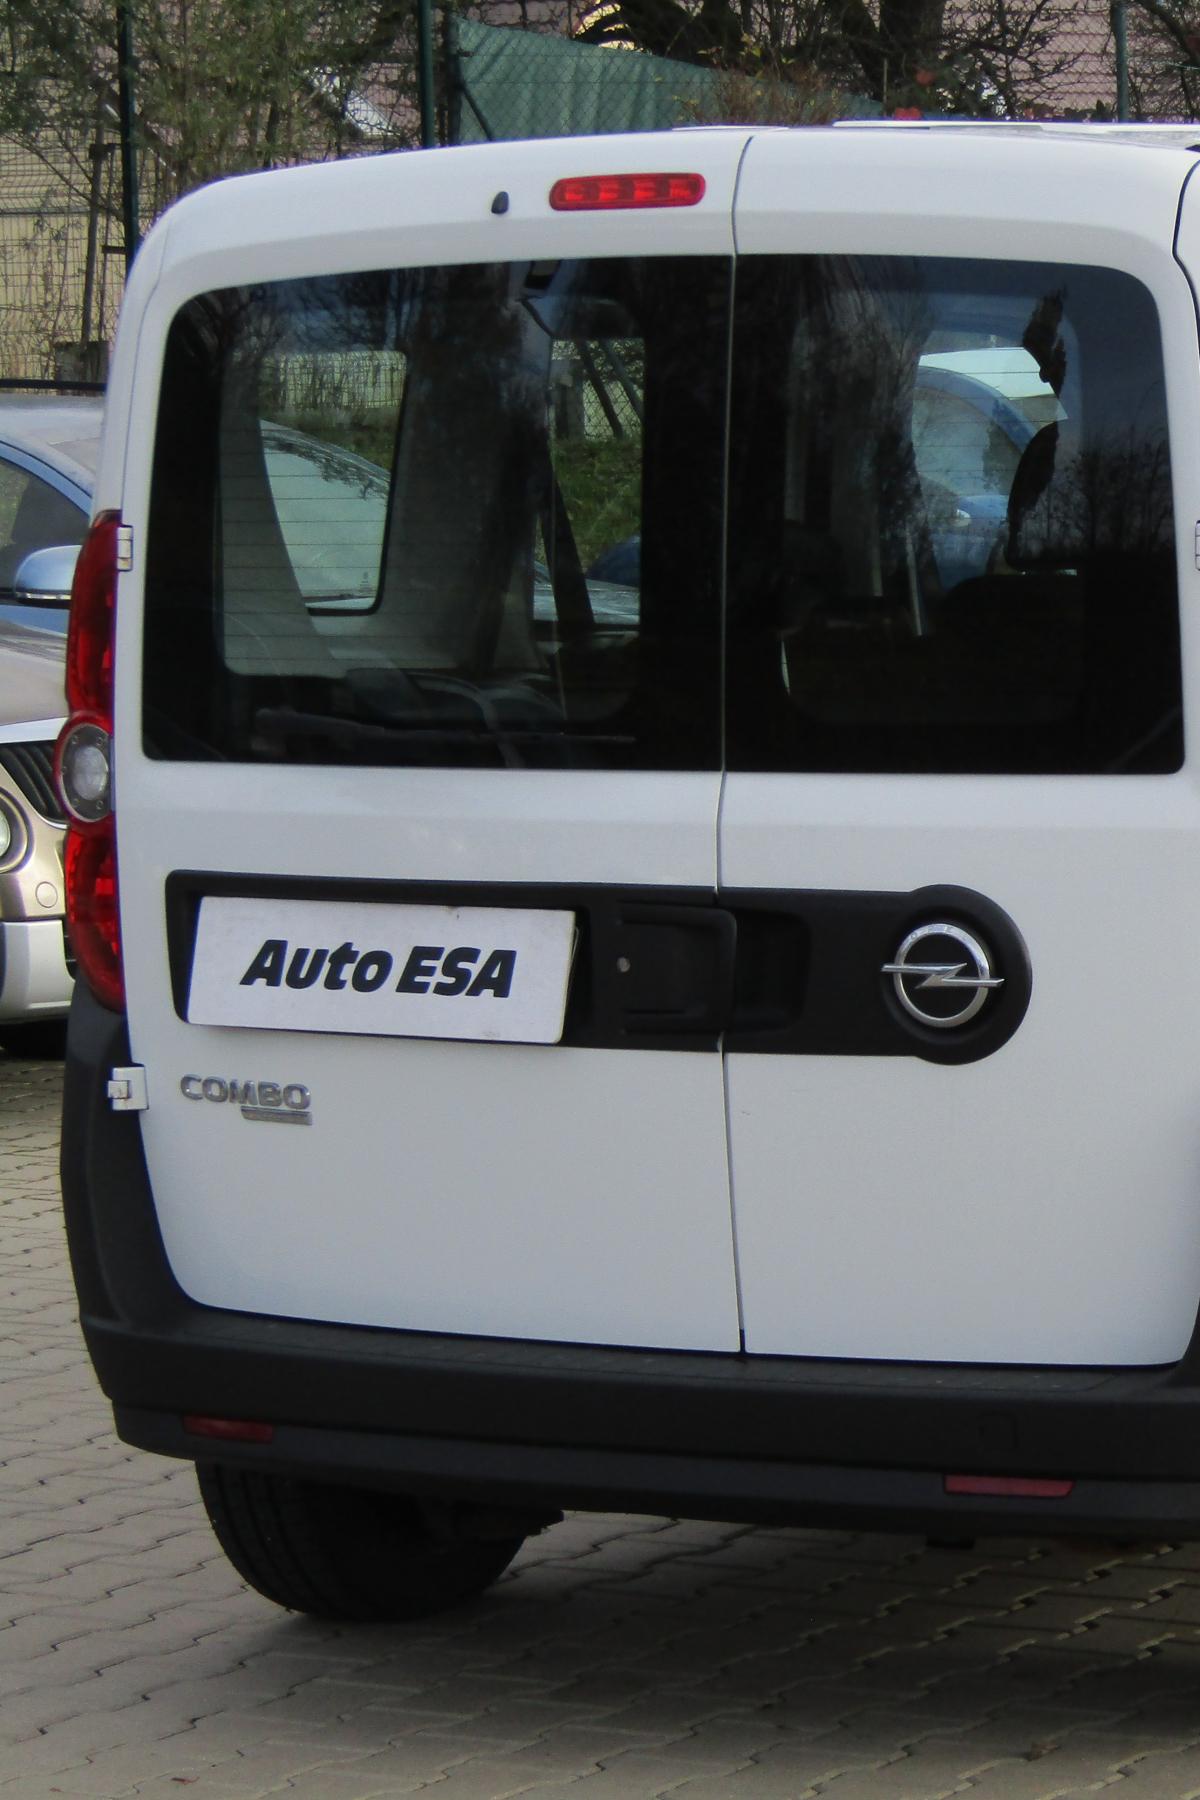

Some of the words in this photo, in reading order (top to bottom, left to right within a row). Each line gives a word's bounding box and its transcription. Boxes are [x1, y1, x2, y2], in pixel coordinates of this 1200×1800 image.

[239, 939, 393, 993] Auto
[395, 945, 517, 998] ESA
[180, 1074, 311, 1110] COMBO
